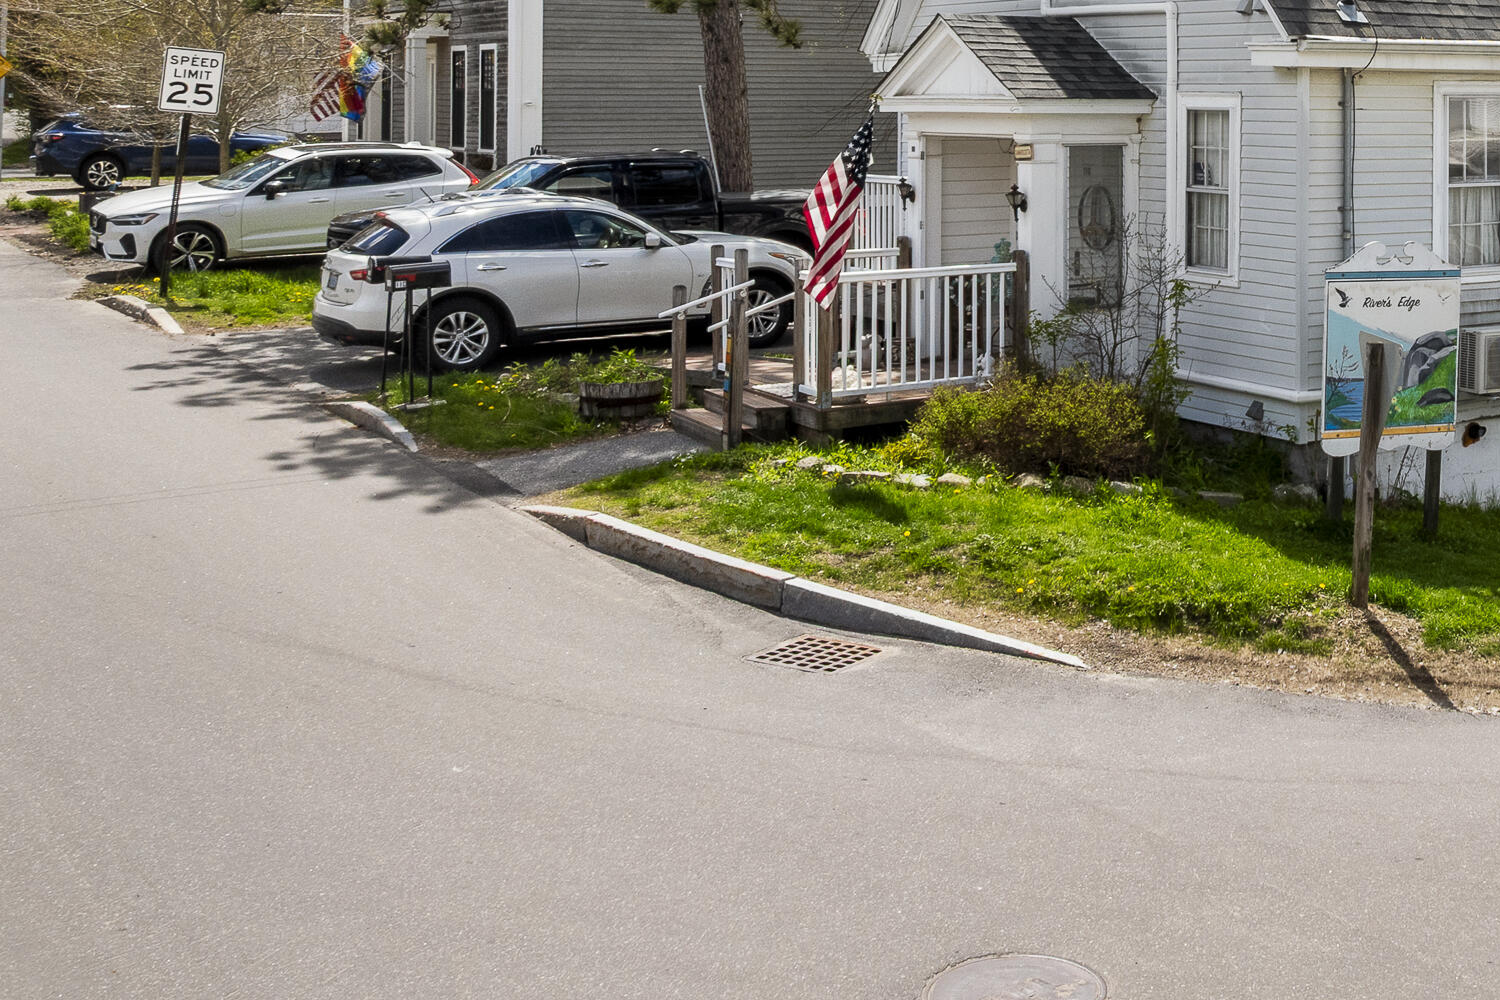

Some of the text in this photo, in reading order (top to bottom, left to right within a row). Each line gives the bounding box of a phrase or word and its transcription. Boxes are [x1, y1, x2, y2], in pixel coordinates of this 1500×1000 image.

[170, 55, 219, 68] SPEED
[174, 68, 212, 80] LIMIT
[166, 81, 213, 105] 25
[1362, 296, 1421, 312] River's Edge
